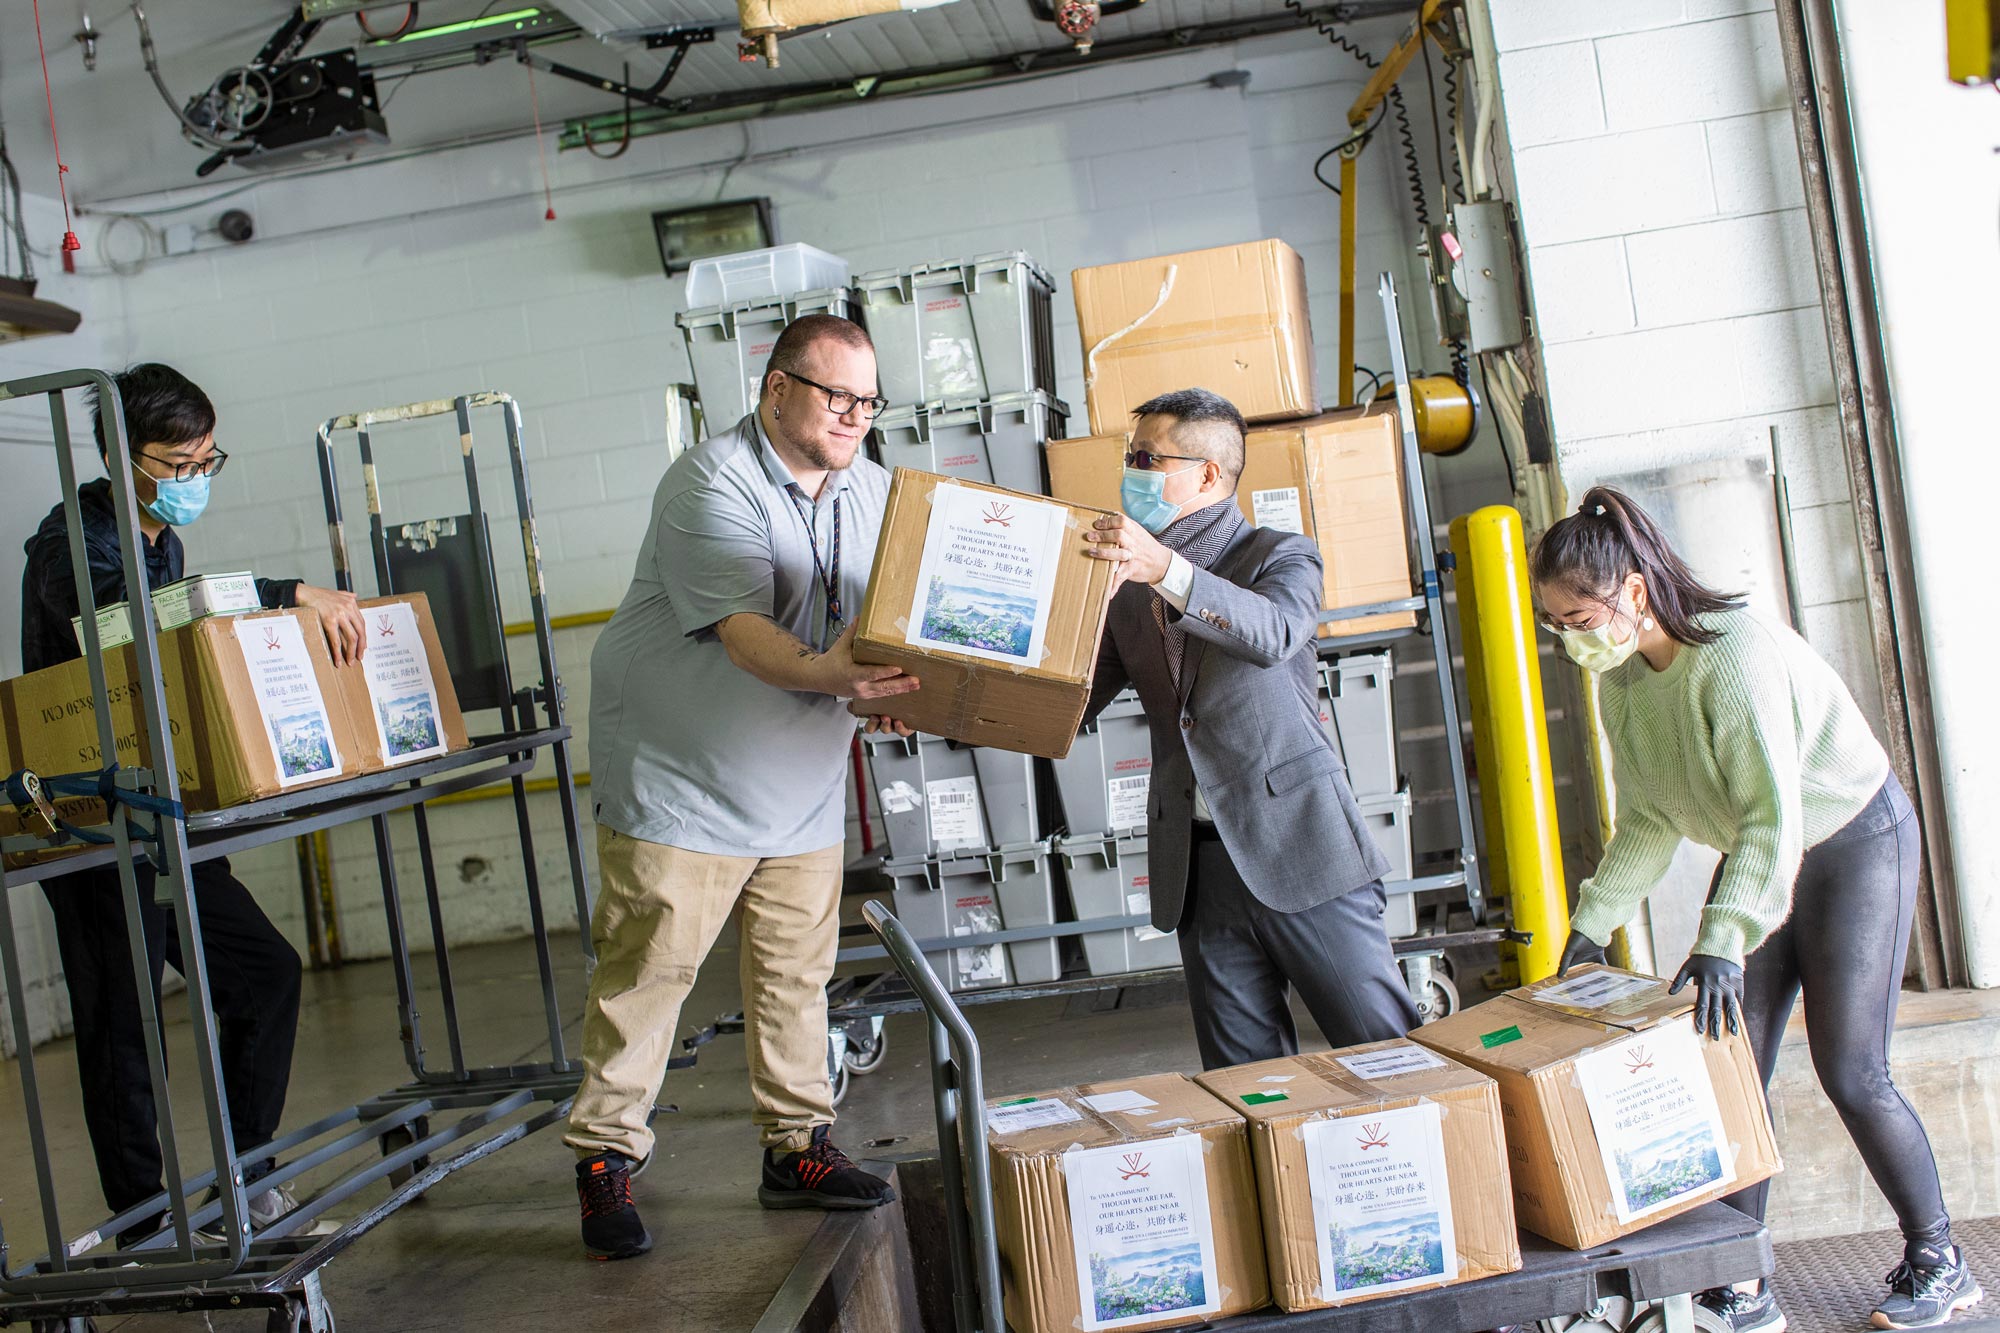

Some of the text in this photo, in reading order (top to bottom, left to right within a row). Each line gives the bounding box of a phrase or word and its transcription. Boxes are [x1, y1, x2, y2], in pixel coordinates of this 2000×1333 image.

[957, 535, 986, 546] THOUGH
[998, 542, 1012, 550] ARE
[974, 529, 1008, 540] COMMUNITY
[951, 543, 1029, 563] OUR HEARTS ARE NEAR
[41, 706, 64, 724] CM
[1616, 1090, 1642, 1105] THOUGH
[1642, 1087, 1652, 1095] WE
[1654, 1082, 1666, 1091] ARE
[1616, 1085, 1685, 1115] OUR HEARTS ARE NEAR
[1355, 1156, 1389, 1166] COMMUNITY
[1340, 1168, 1370, 1179] THOUGH
[1383, 1164, 1397, 1172] ARE
[1338, 1171, 1418, 1190] OUR HEARTS ARE NEAR
[1116, 1187, 1150, 1196] COMMUNITY
[1099, 1202, 1179, 1220] OUR HEARTS ARE NEAR
[1101, 1198, 1130, 1209] THOUGH
